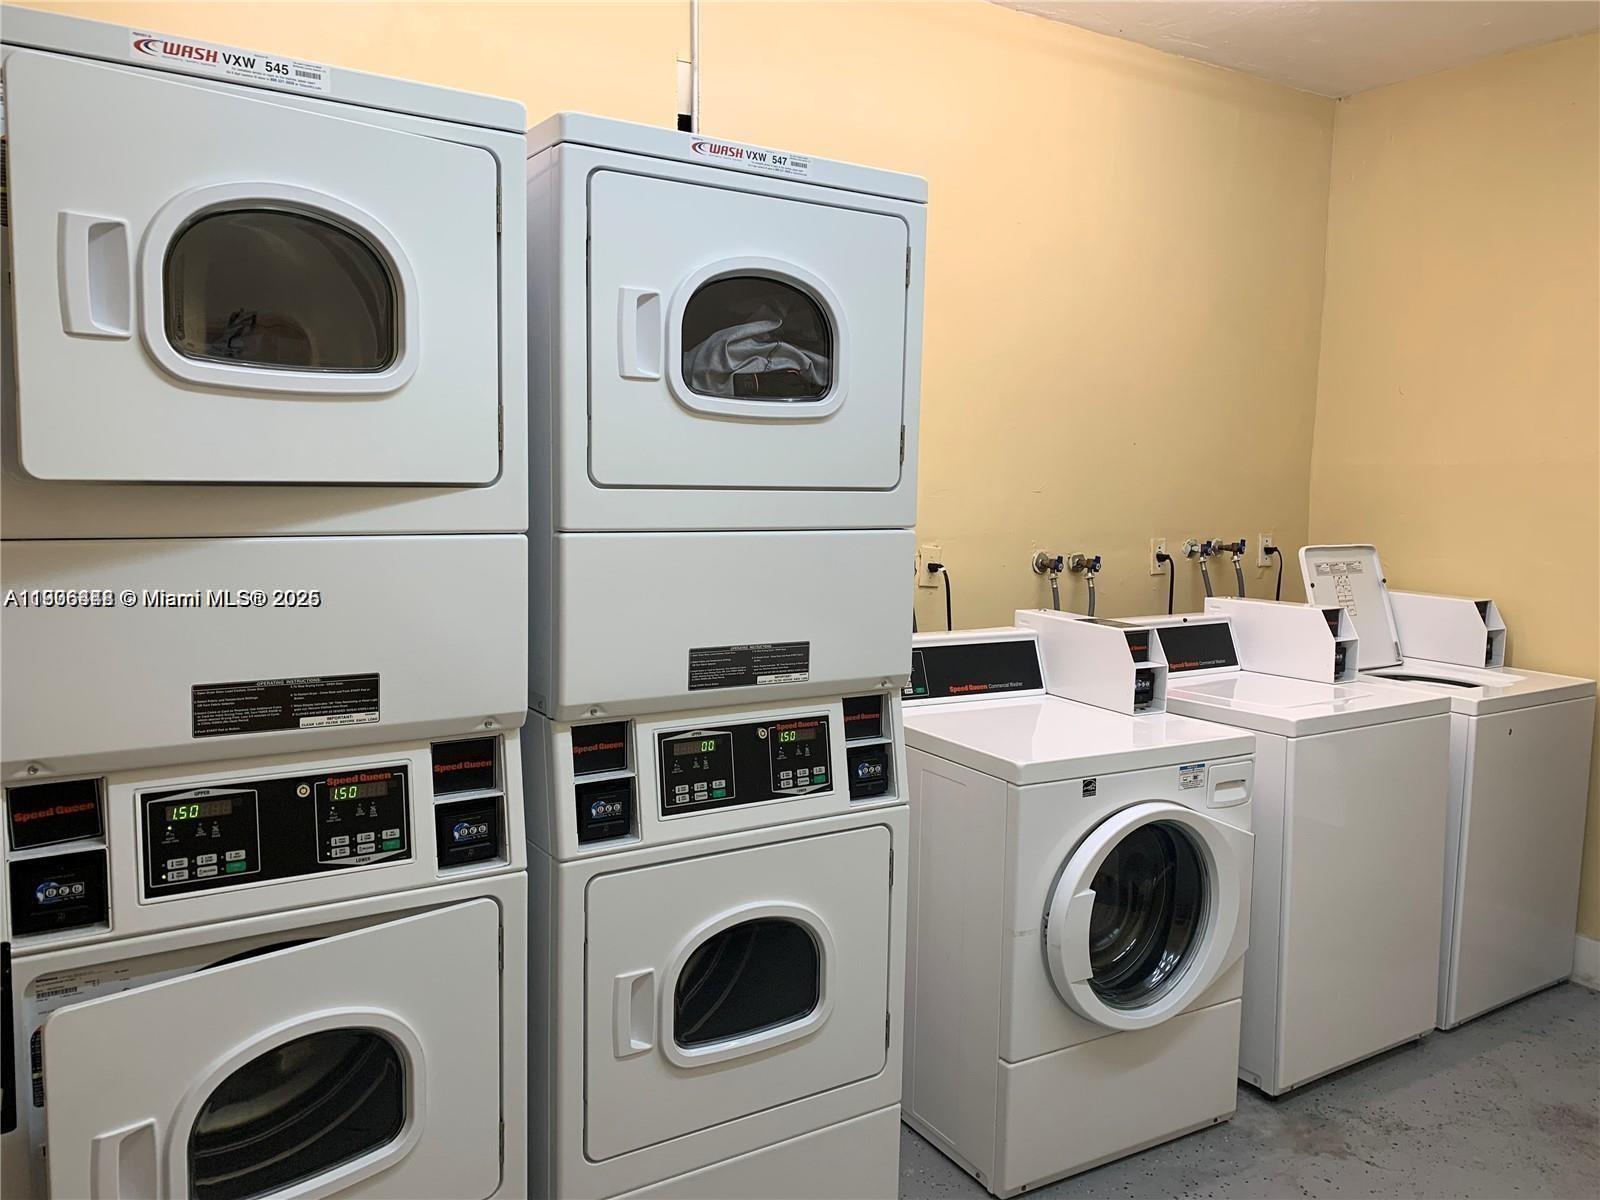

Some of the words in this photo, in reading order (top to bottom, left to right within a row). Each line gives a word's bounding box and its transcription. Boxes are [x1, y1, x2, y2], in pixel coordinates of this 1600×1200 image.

[162, 41, 218, 63] WASH
[222, 52, 256, 69] VXW
[265, 61, 289, 75] 545
[709, 143, 744, 159] WASH
[745, 150, 767, 162] VXW
[772, 155, 788, 166] 547
[949, 684, 969, 694] Speed
[969, 683, 988, 691] Queen
[776, 722, 797, 731] Speed
[598, 741, 624, 750] Queen
[434, 762, 463, 773] Speed
[463, 760, 492, 769] Queen
[326, 775, 358, 786] Speed
[359, 772, 392, 782] Queen
[13, 807, 54, 823] Speed
[55, 801, 95, 815] Queen
